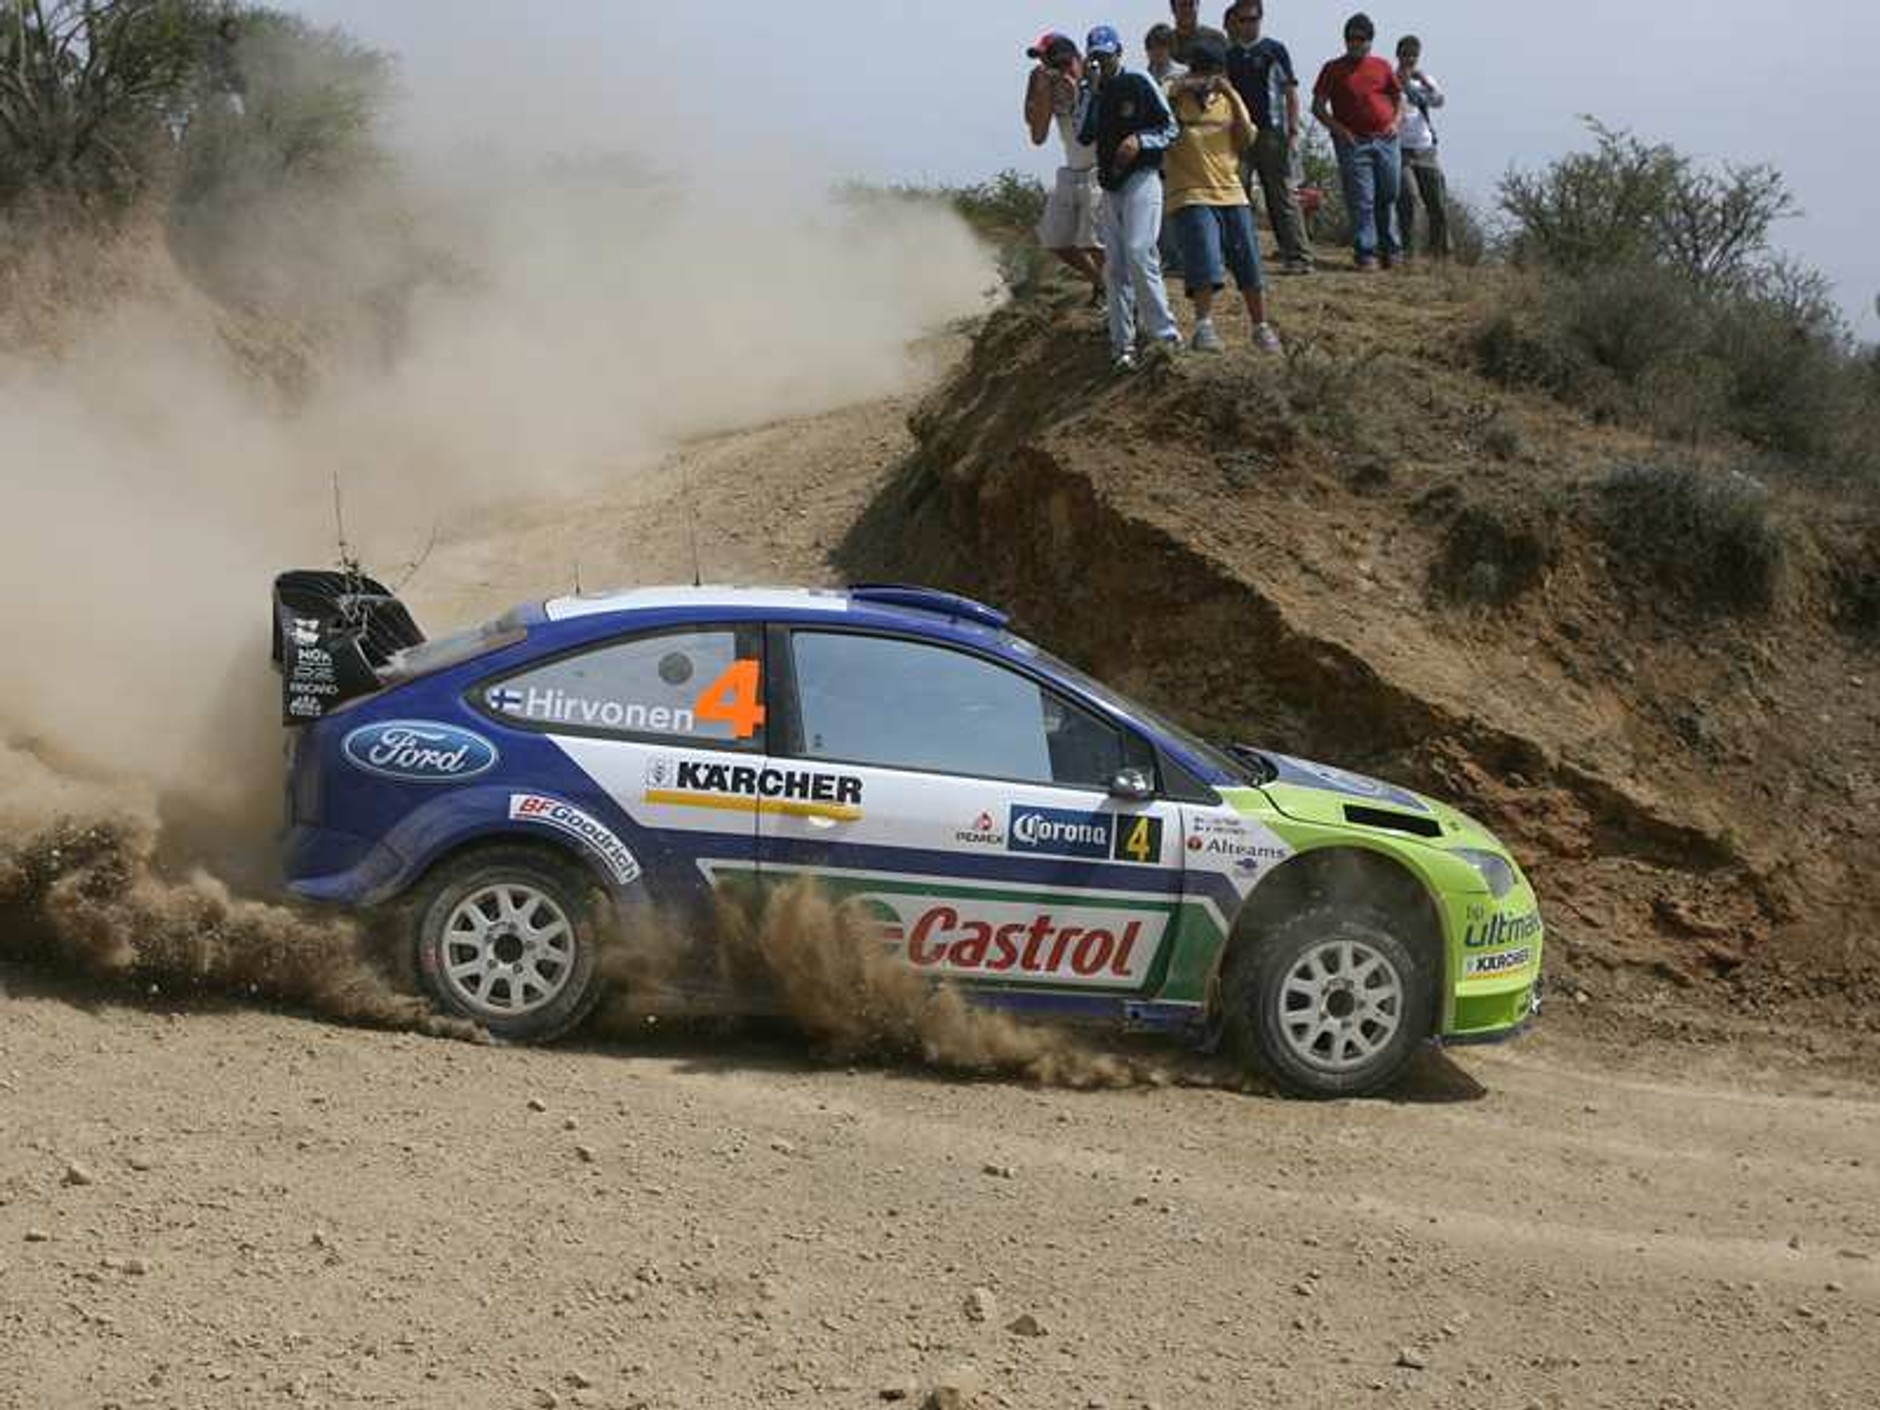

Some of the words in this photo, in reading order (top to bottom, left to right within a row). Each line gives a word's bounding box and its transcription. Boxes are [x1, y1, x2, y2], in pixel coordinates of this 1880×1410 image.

[526, 686, 694, 732] Hirvonen
[695, 656, 766, 737] 4
[369, 728, 469, 772] Ford
[676, 761, 864, 804] KÄRCHER
[1013, 813, 1107, 846] Corona
[1127, 816, 1151, 862] 4
[908, 906, 1142, 976] Castrol
